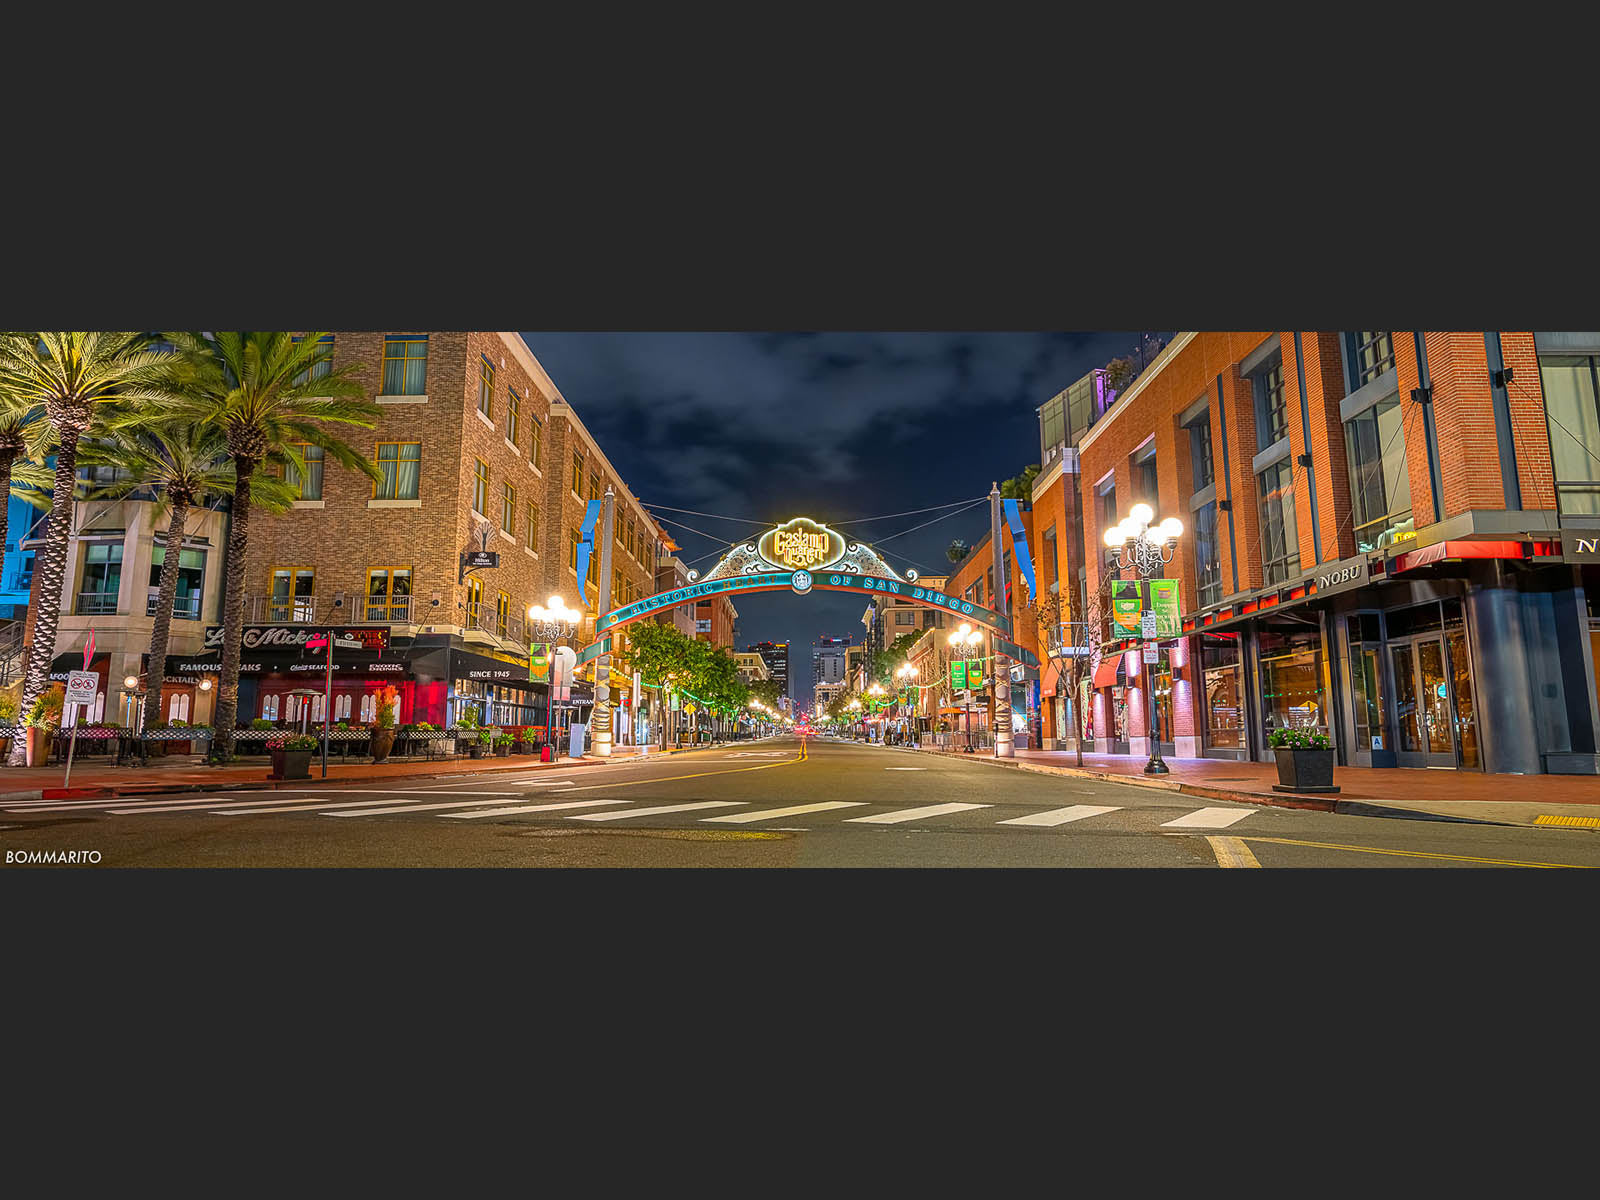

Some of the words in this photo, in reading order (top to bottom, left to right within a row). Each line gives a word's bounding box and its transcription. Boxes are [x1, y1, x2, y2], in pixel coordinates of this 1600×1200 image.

[774, 527, 829, 555] Gaslamp
[783, 546, 824, 567] Quarter
[1320, 565, 1360, 589] NOBU
[630, 583, 713, 615] HISTORIC
[722, 575, 777, 589] HEART
[830, 575, 852, 586] OF
[864, 577, 900, 594] SAN
[912, 587, 974, 615] DIEGO
